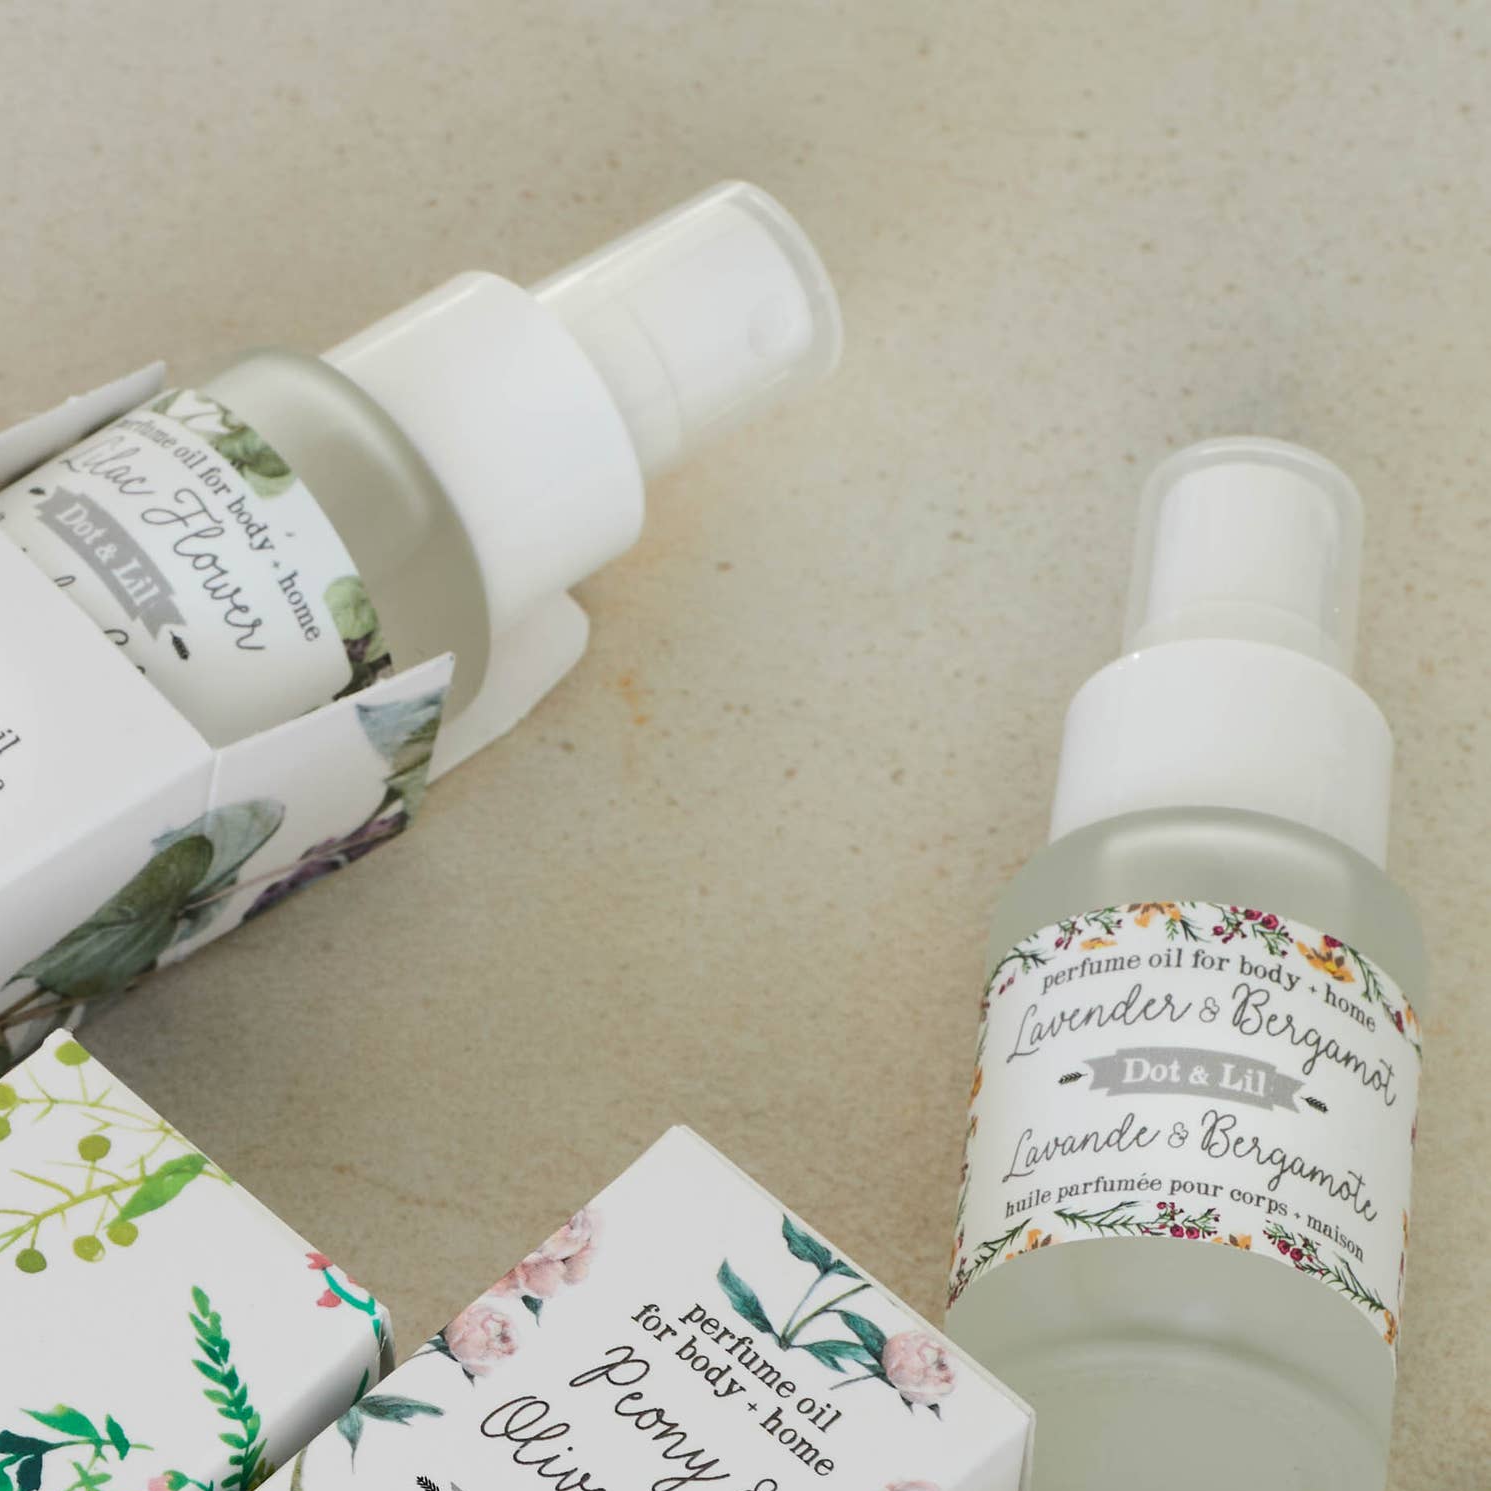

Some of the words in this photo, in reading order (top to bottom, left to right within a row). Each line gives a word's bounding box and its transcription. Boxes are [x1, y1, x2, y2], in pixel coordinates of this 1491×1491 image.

[55, 502, 108, 545] Dot
[112, 554, 160, 607] Lil
[59, 436, 156, 494] Lilac
[140, 487, 266, 651] Flower
[174, 447, 207, 470] oil
[197, 466, 232, 496] for
[225, 494, 276, 551] body
[277, 569, 321, 642] home
[1005, 982, 1193, 1065] Lavender
[1198, 996, 1221, 1024] &
[1231, 981, 1397, 1108] Bergamot
[1040, 954, 1142, 997] perfume
[1147, 947, 1184, 969] oil
[1191, 948, 1231, 972] for
[1237, 954, 1302, 996] body
[1323, 979, 1380, 1033] home
[1122, 1058, 1168, 1084] Dot
[1218, 1066, 1266, 1097] Lil
[1001, 1111, 1162, 1184] Lavande
[1166, 1120, 1190, 1149] &
[1200, 1108, 1378, 1223] Bergamote
[1004, 1188, 1052, 1220] huile
[1054, 1172, 1163, 1205] parfumée
[1166, 1178, 1225, 1198] pour
[1229, 1188, 1289, 1217] corps
[1306, 1213, 1364, 1267] maison
[630, 1303, 679, 1343] for
[674, 1333, 748, 1399] body
[758, 1405, 835, 1477] home
[677, 1302, 797, 1399] perfume
[795, 1397, 843, 1435] oil
